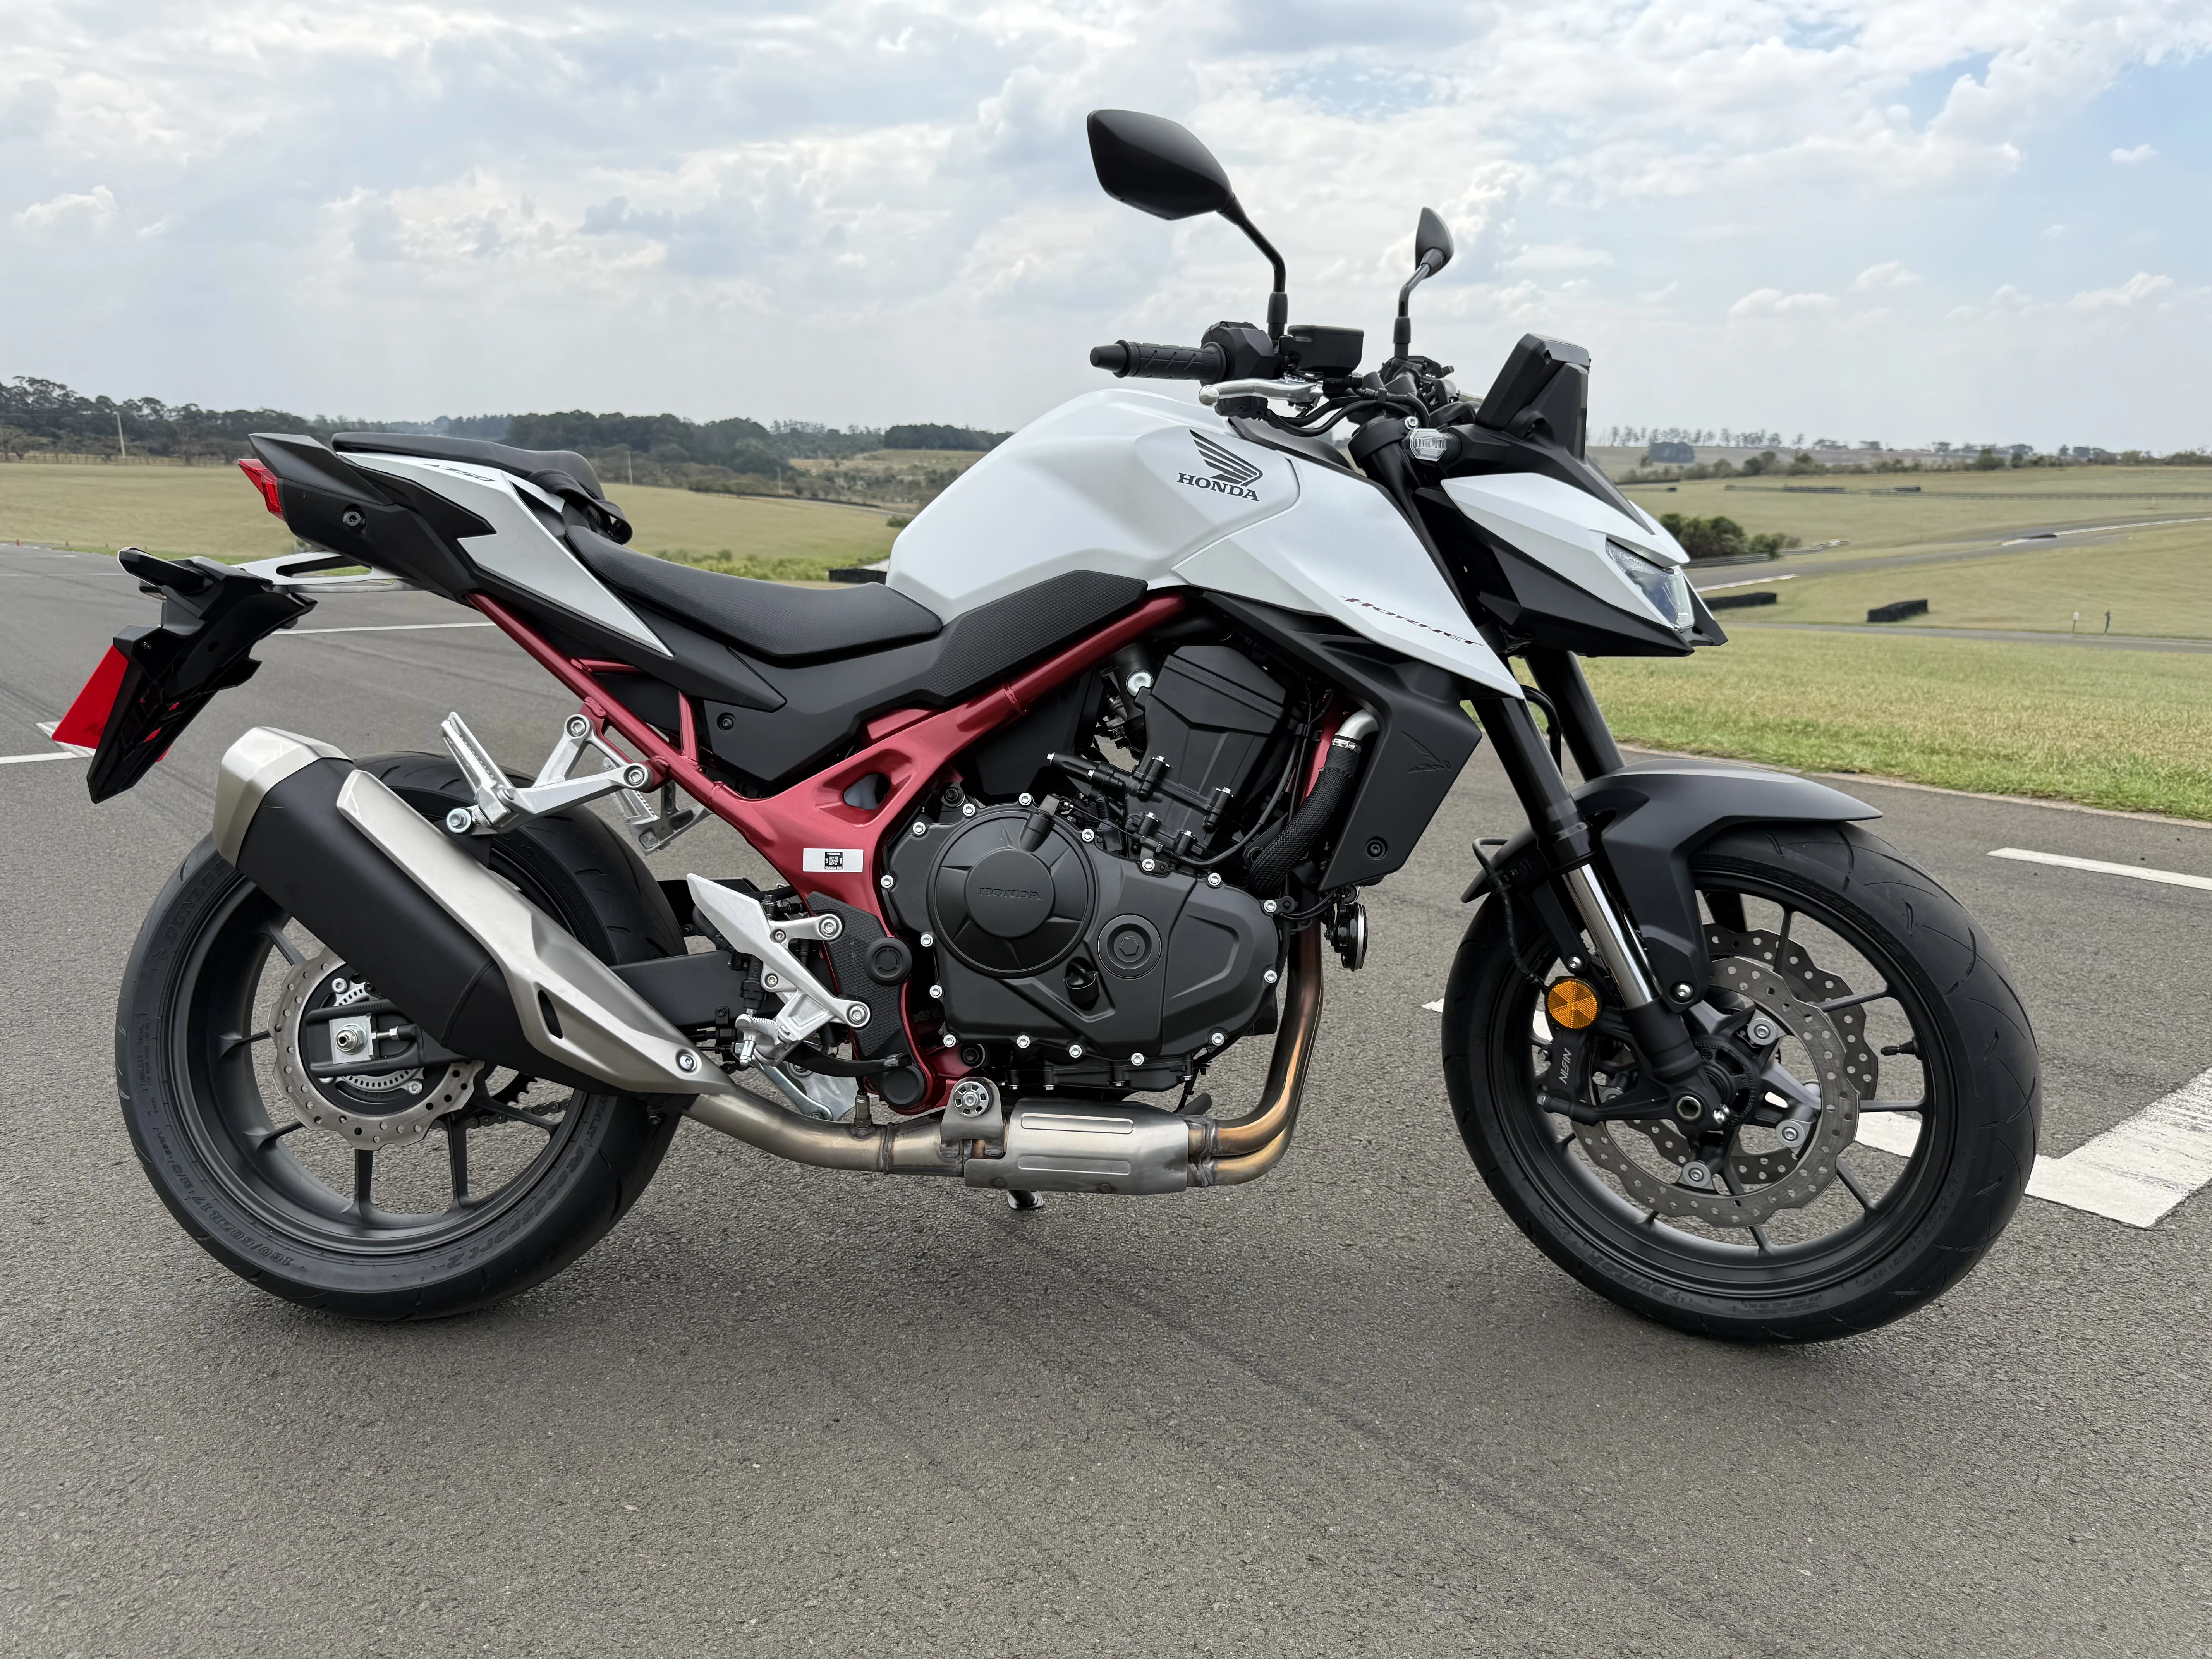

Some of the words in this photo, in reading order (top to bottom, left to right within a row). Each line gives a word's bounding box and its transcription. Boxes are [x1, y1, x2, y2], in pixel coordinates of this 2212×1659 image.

[1176, 472, 1260, 502] HONDA
[163, 859, 227, 945] DUNLOP
[978, 887, 1042, 900] HONDA
[138, 1055, 146, 1087] TUBELESS
[1559, 1048, 1571, 1085] NISSIN
[467, 1145, 584, 1259] Roadsport
[192, 1196, 294, 1266] 160/60ZR17
[447, 1252, 465, 1269] 2
[1587, 1253, 1667, 1296] DUNLOP
